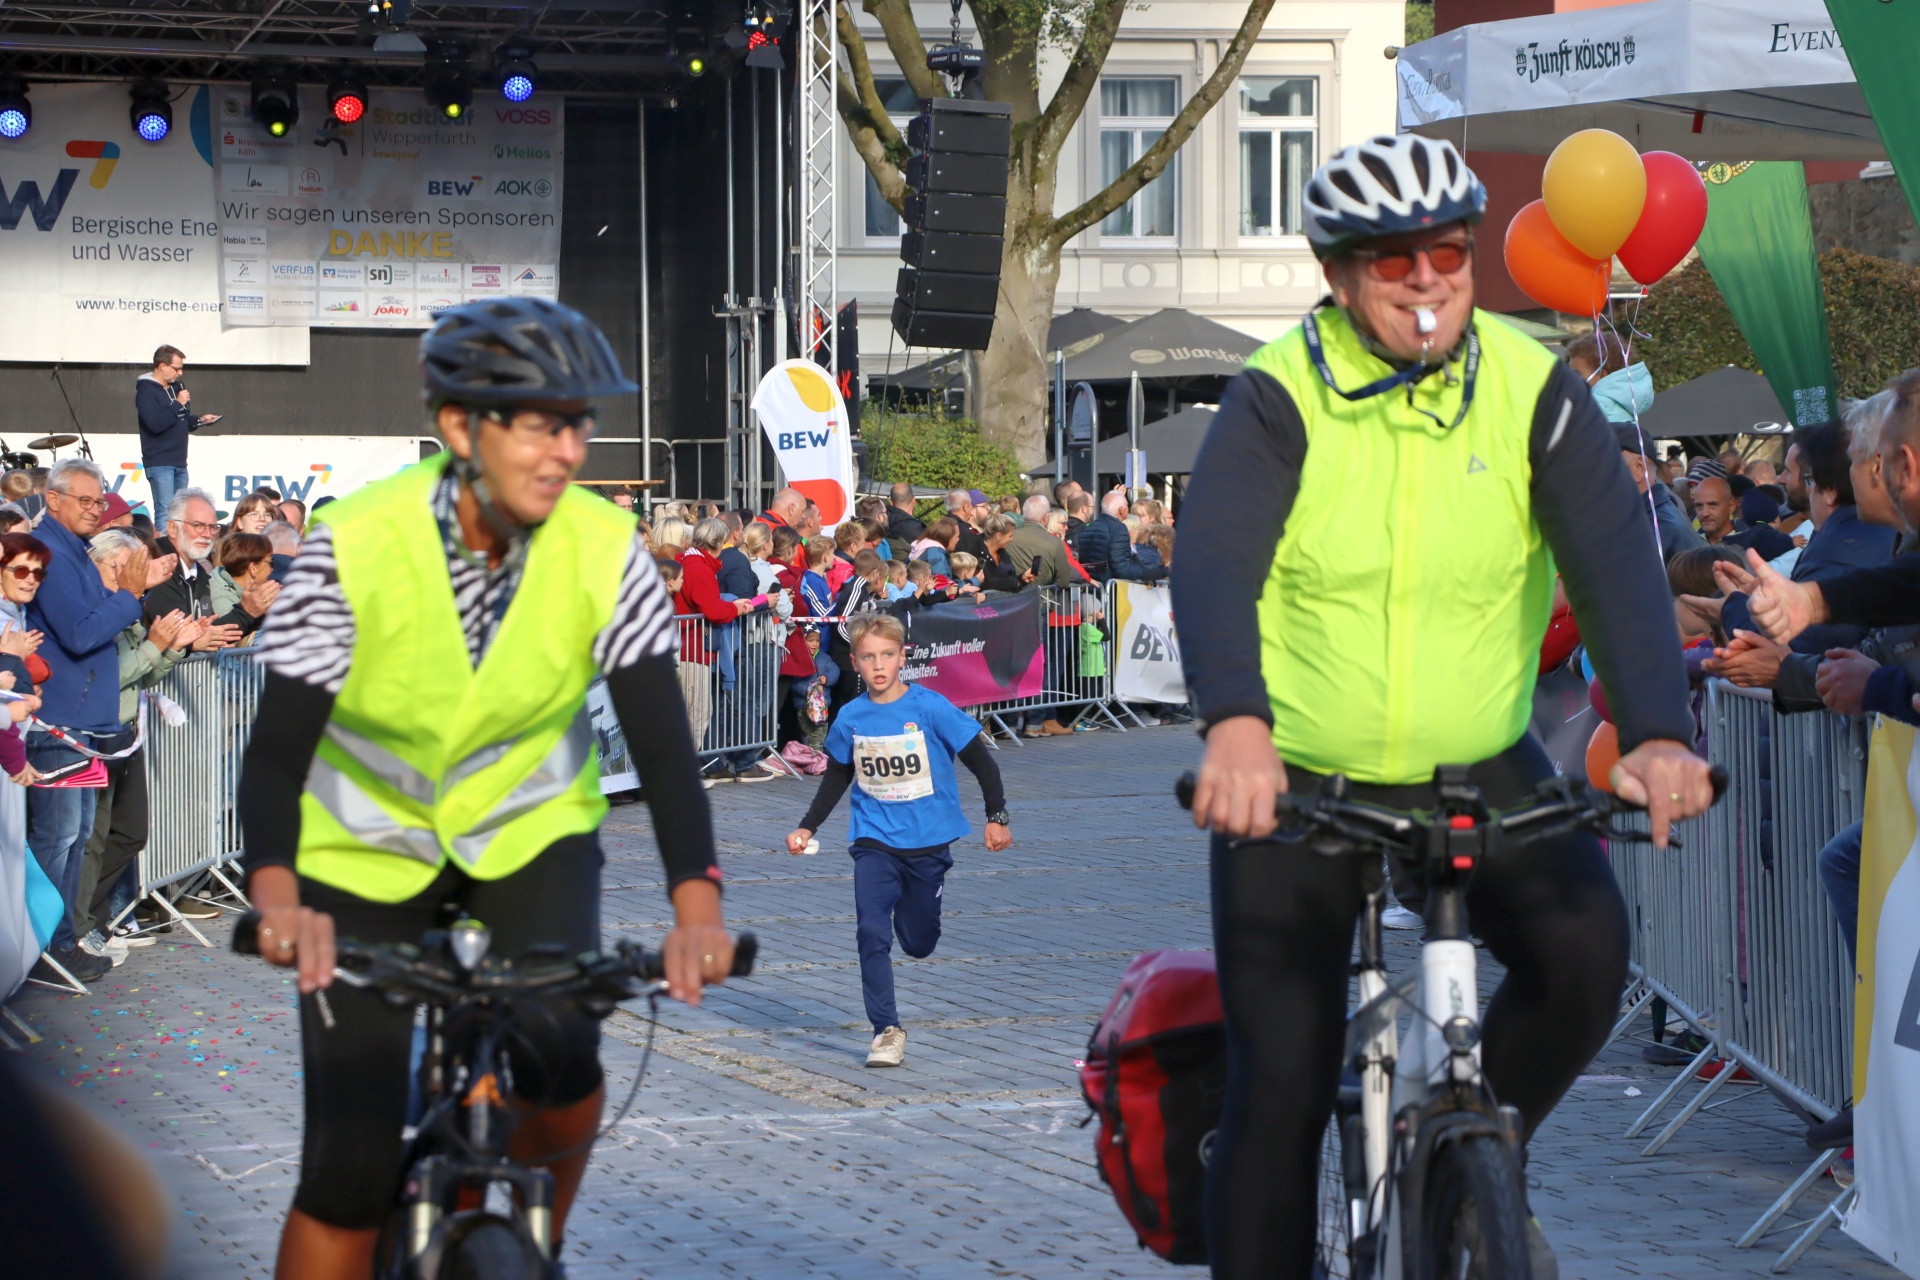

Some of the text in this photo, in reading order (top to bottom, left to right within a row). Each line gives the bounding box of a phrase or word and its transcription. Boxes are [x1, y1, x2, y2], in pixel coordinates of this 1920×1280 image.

[1528, 38, 1621, 83] Zunft KÖLSCH
[495, 109, 551, 125] VOSS
[239, 139, 294, 149] Kreissparkasse
[239, 148, 256, 156] Köln
[506, 146, 551, 160] Helios
[299, 185, 323, 193] Radium
[428, 181, 475, 196] BEW
[494, 180, 532, 195] AOK
[223, 202, 554, 228] Wir sagen unseren Sponsoren
[72, 216, 218, 238] Bergische Ene
[223, 236, 246, 245] Habia
[329, 230, 453, 257] DANKE
[72, 243, 193, 262] und Wasser
[75, 298, 224, 313] www.bergische-ener
[373, 305, 409, 316] jokey
[779, 429, 830, 450] BEW
[908, 638, 986, 660] ine Zukunft voller
[860, 753, 921, 777] 5099
